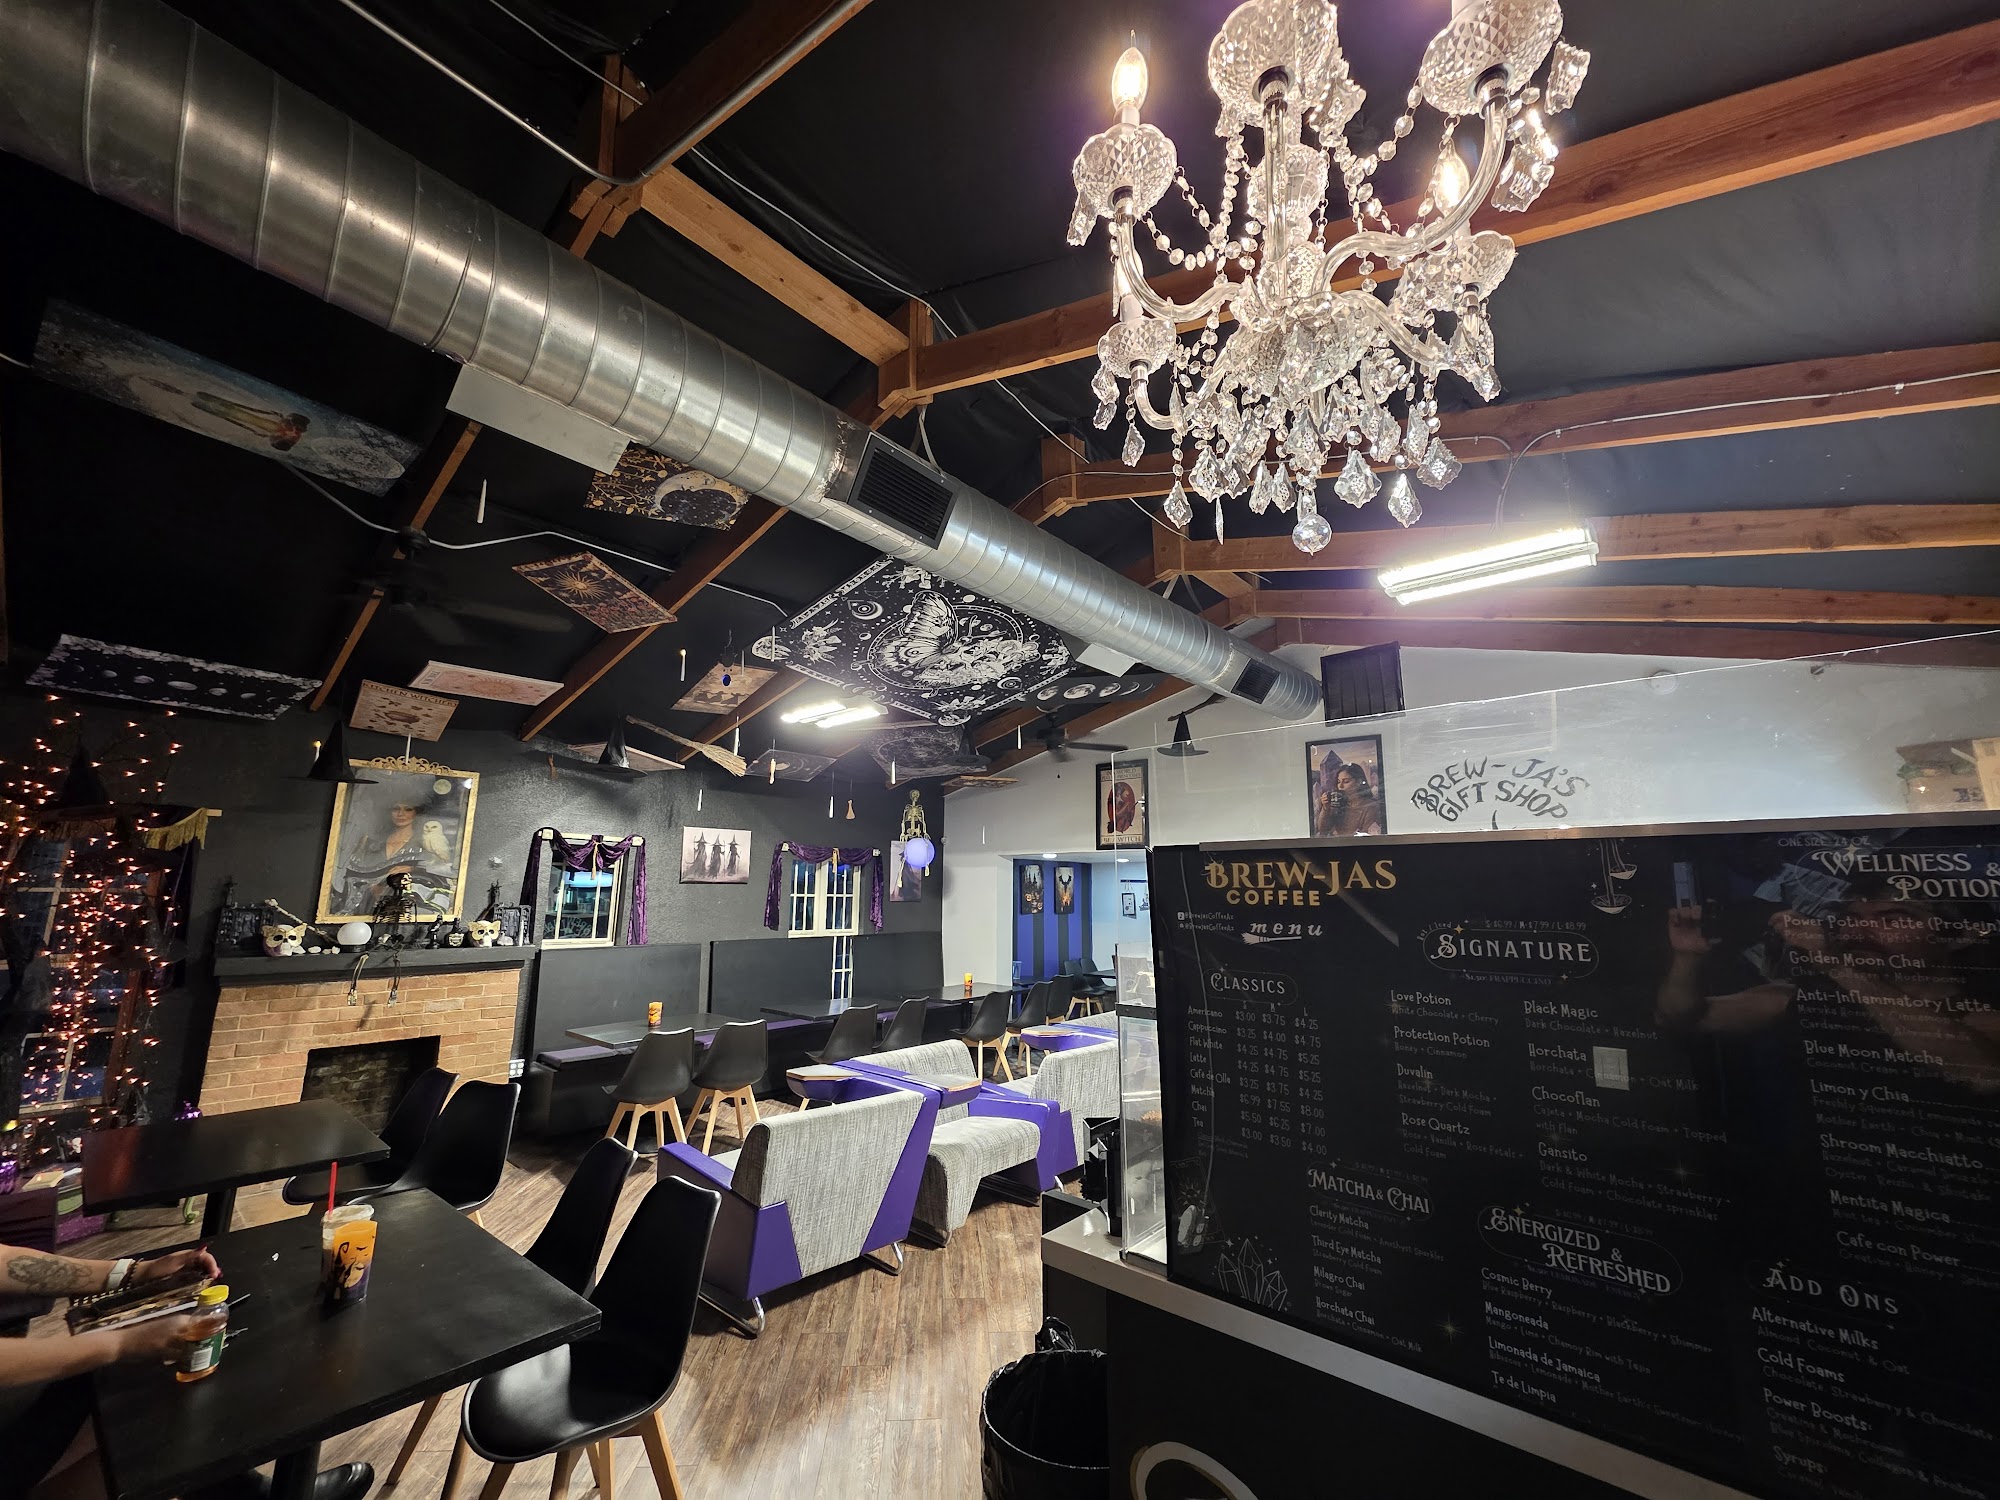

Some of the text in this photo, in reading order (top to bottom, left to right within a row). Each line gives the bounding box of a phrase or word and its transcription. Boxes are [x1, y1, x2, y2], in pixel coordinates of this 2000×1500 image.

[1439, 780, 1568, 821] GIFT SHOP
[1811, 851, 2000, 876] WELLNESS &
[1204, 859, 1397, 895] BREW-JAS
[1227, 890, 1320, 906] COFFEE
[1250, 922, 1322, 936] menu
[1784, 915, 1823, 928] Power
[1828, 916, 1879, 929] Potion
[1882, 917, 1923, 930] Latte
[1430, 934, 1592, 963] SIGNATURE
[1790, 951, 1926, 968] Golden Moon Chai
[1211, 973, 1284, 994] CLASSICS
[1391, 990, 1452, 1005] Love Potion
[1524, 1001, 1598, 1019] Black Magic
[1797, 988, 1991, 1013] Anti-Inflammatory Latte
[1188, 1006, 1319, 1030] Americano $3.00 $3.75 $4.25
[1417, 1008, 1459, 1019] Chocolate
[1468, 1013, 1498, 1025] Cherry
[1525, 1018, 1658, 1040] Dark Chocolate Hazelnut
[1188, 1021, 1321, 1048] Cappuccino $3.25 $4.00 $4.75
[1394, 1026, 1490, 1048] Protection Potion
[1190, 1037, 1319, 1065] Flat White $4.25 $4.75 $5.25
[1395, 1042, 1467, 1059] Honey Cinnamon
[1528, 1043, 1587, 1061] Horchata
[1804, 1040, 1944, 1066] Blue Moon Matcha
[1190, 1052, 1321, 1083] Latte $4.25 $4.75 $5.25
[1397, 1064, 1433, 1080] Duvalin
[1530, 1061, 1574, 1075] Horchata
[1216, 1073, 1230, 1084] Olla
[1240, 1077, 1259, 1089] $3.25
[1266, 1082, 1289, 1095] $3.75
[1299, 1088, 1323, 1101] $4.25
[1441, 1086, 1459, 1097] Dark
[1462, 1090, 1490, 1102] Mocha
[1531, 1086, 1600, 1107] Chocoflan
[1810, 1079, 1909, 1102] Limon y Chia
[1191, 1085, 1214, 1097] Matcha
[1240, 1094, 1260, 1106] $6.99
[1301, 1105, 1324, 1118] $8.00
[1399, 1094, 1491, 1116] Strawberry Cold Foam
[1192, 1101, 1325, 1136] Chai $5.50 $6.25 $7.00
[1402, 1112, 1470, 1135] Rose Quartz
[1613, 1116, 1638, 1129] Cold
[1683, 1127, 1727, 1143] Topped
[1192, 1117, 1327, 1155] Tea $3.00 $3.50 $4.00
[1538, 1142, 1588, 1161] Gansito
[1820, 1133, 1882, 1154] Shroom
[1885, 1142, 1983, 1169] Macchiatto
[1308, 1169, 1375, 1200] MATCHA
[1376, 1190, 1383, 1200] &
[1387, 1187, 1429, 1213] CHAI
[1310, 1205, 1337, 1223] Clarity
[1339, 1213, 1369, 1230] Matcha
[1830, 1189, 1950, 1223] Mentita Magica
[1484, 1208, 1600, 1251] ENERGIZED
[1312, 1234, 1381, 1264] Third Eye Matcha
[1611, 1248, 1623, 1262] &
[1836, 1230, 1873, 1249] Cafe
[1877, 1242, 1907, 1258] con
[1910, 1244, 1960, 1267] Power
[1313, 1266, 1365, 1291] Milagro Chai
[1542, 1243, 1670, 1293] REFRESHED
[1481, 1267, 1520, 1286] Cosmic
[1522, 1277, 1552, 1299] Berry
[1762, 1268, 1899, 1314] ADD ONS
[1316, 1296, 1375, 1325] Horchata Chai
[1485, 1301, 1549, 1330] Mangoneada
[1752, 1306, 1879, 1350] Alternative Milks
[1488, 1336, 1600, 1383] Limonada de Jamaica
[1758, 1347, 1845, 1382] Cold Foams
[1491, 1369, 1556, 1403] Te de Limpia
[1763, 1387, 1872, 1431] Power Boosts:
